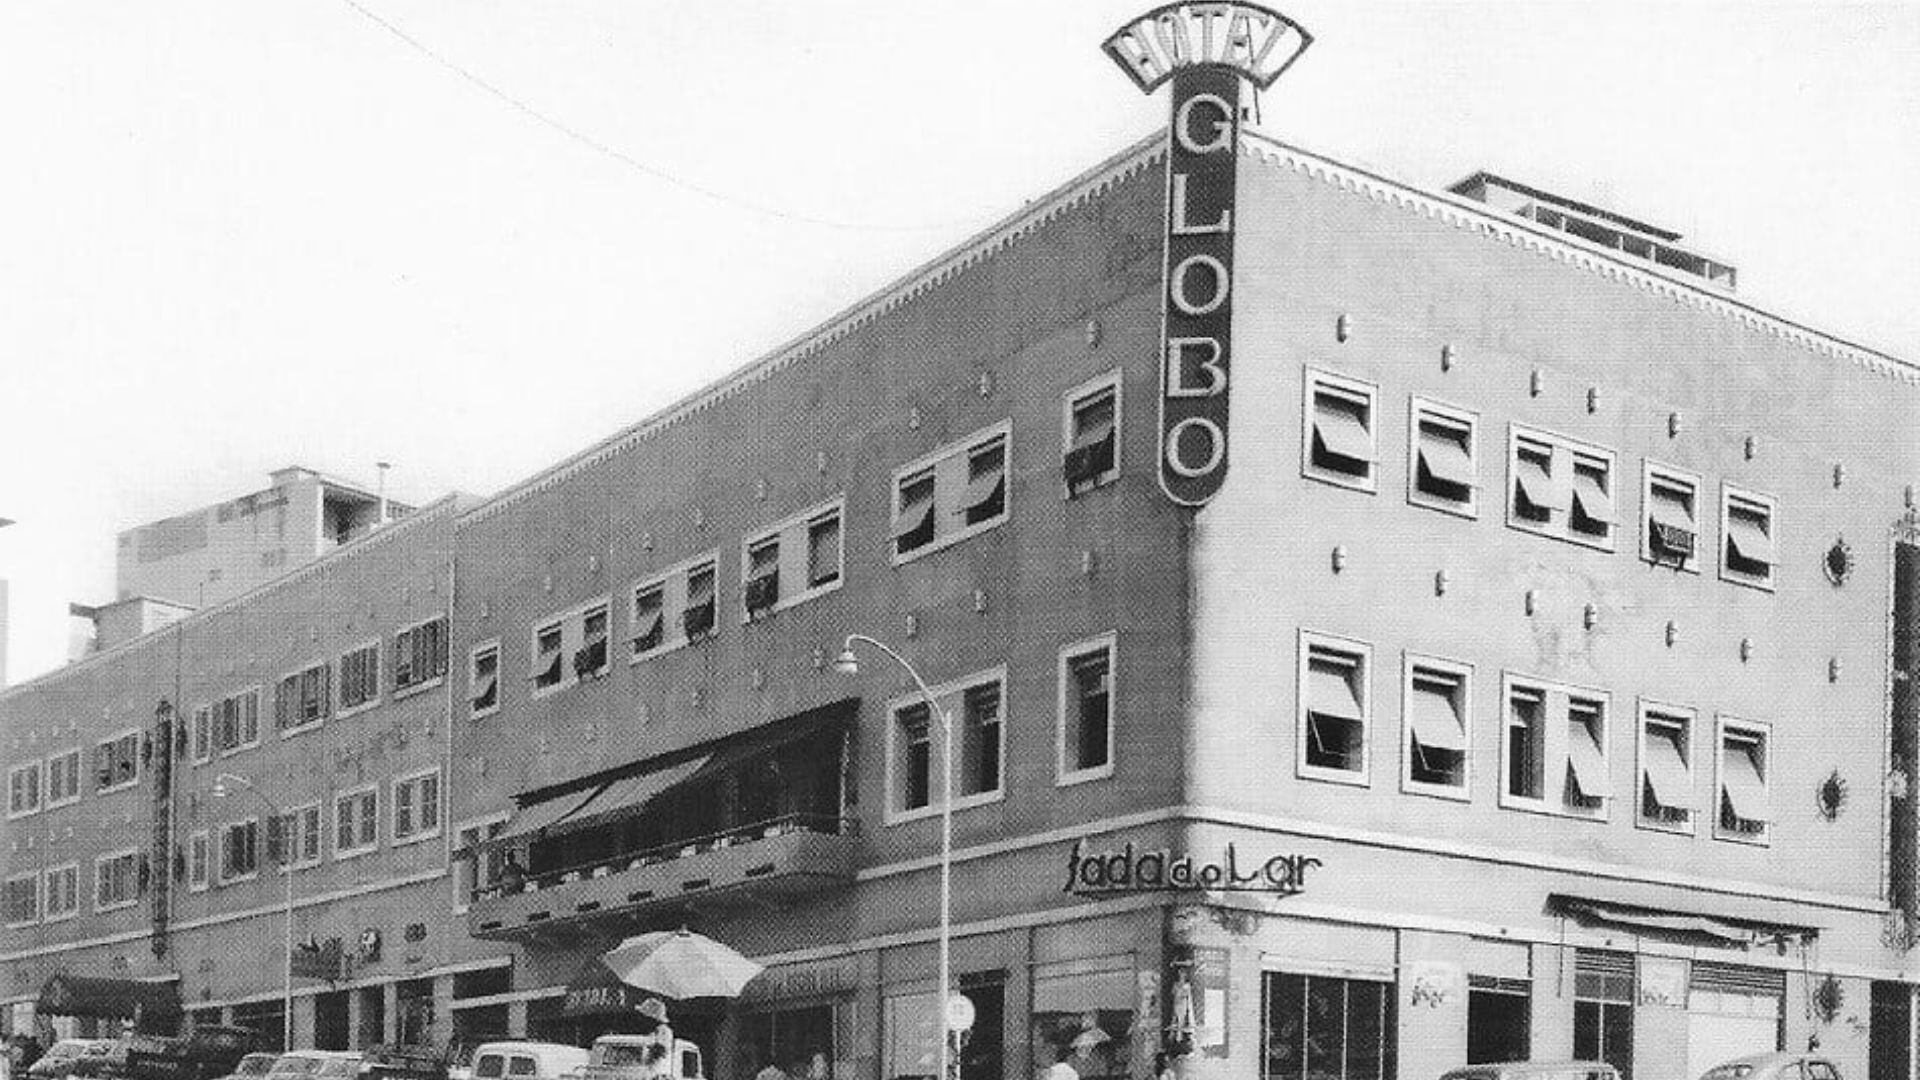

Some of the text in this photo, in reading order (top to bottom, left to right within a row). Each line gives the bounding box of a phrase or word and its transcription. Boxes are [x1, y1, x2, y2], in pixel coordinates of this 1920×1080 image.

[1112, 3, 1294, 84] HOTEL
[1166, 93, 1233, 478] GLOBO
[1170, 856, 1221, 884] do
[1226, 842, 1323, 892] Lar
